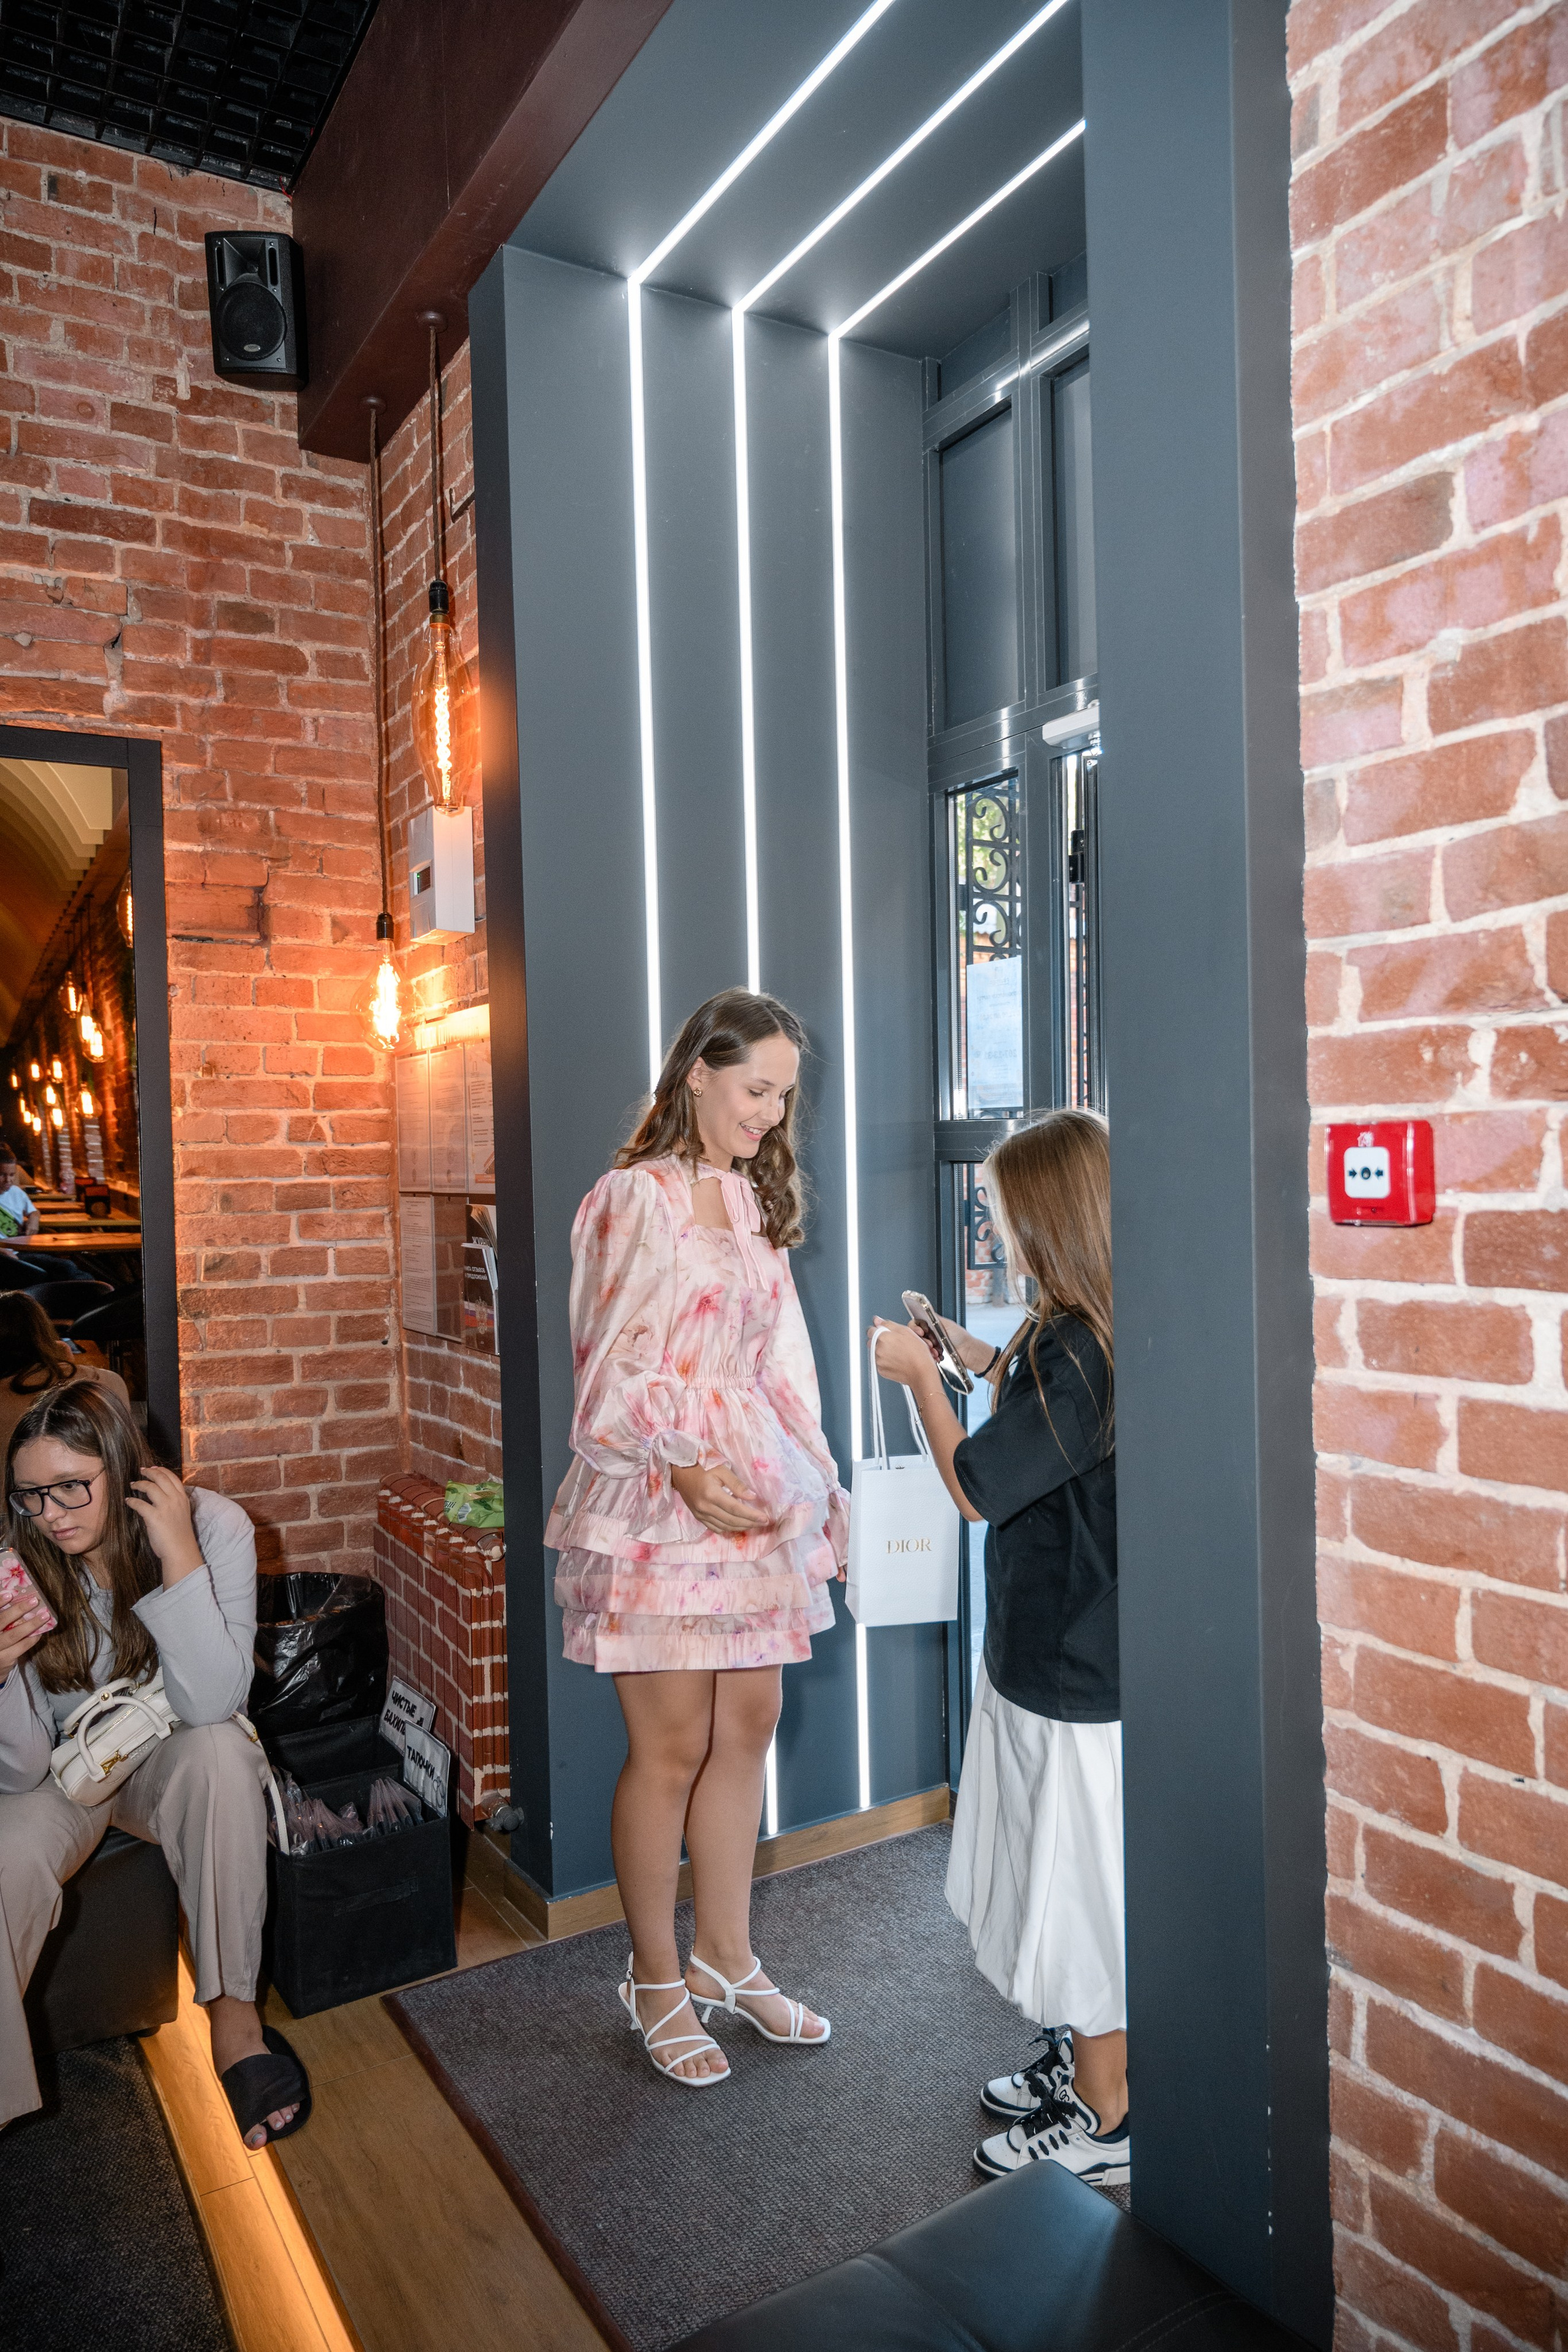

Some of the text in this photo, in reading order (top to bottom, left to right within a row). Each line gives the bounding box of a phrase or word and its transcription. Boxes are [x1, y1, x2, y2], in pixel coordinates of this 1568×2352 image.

[886, 1538, 932, 1554] DIOR
[392, 1690, 417, 1718] ЧИСТЫЕ
[407, 1745, 435, 1780] ТАПОЧКИ
